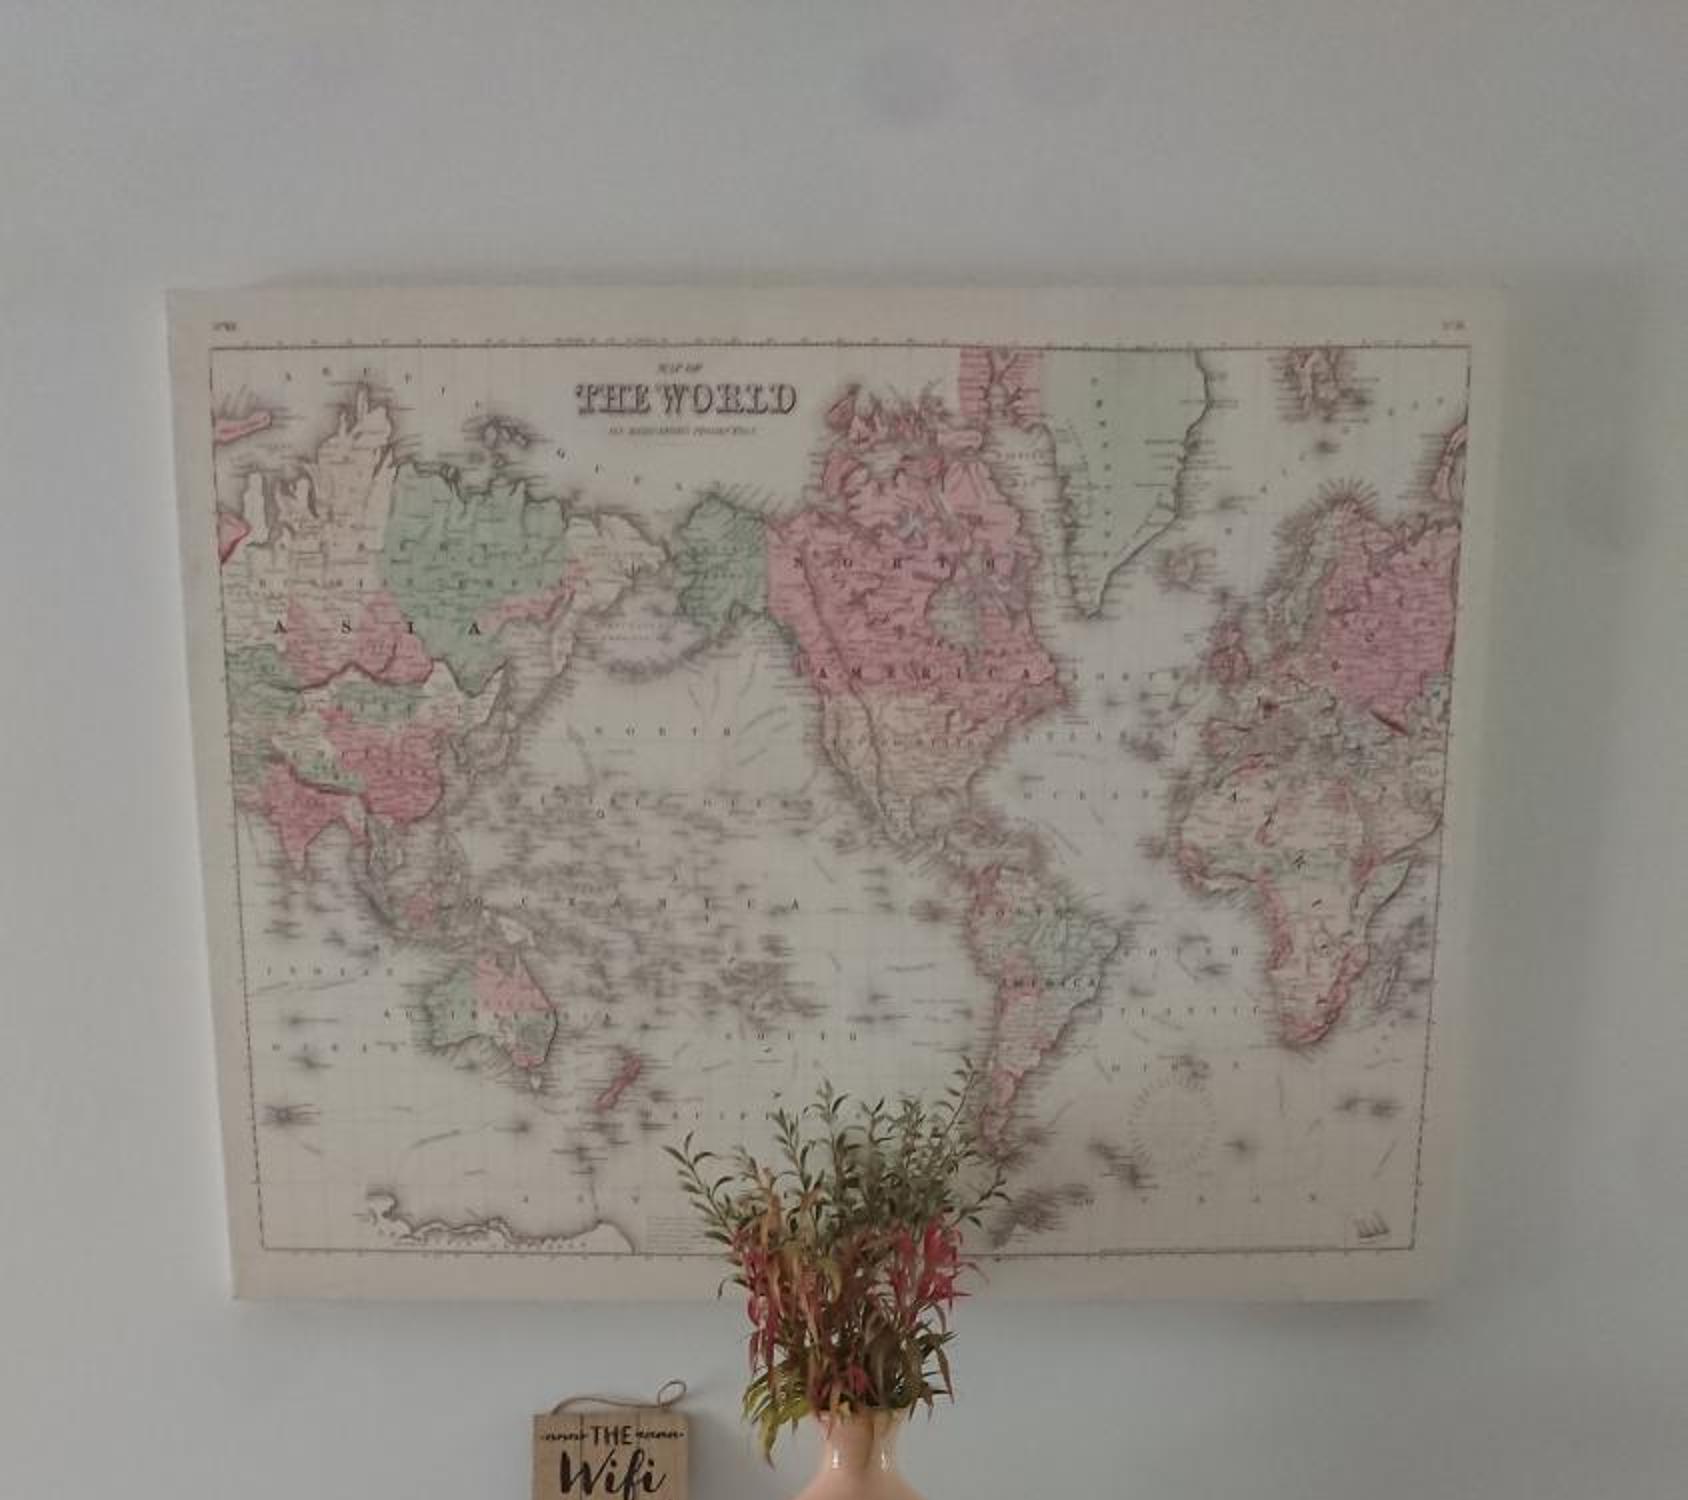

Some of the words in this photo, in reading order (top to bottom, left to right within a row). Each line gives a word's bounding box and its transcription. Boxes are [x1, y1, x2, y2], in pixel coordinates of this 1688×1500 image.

[575, 383, 651, 417] THE
[654, 382, 797, 417] WORLD
[589, 1424, 633, 1446] THE
